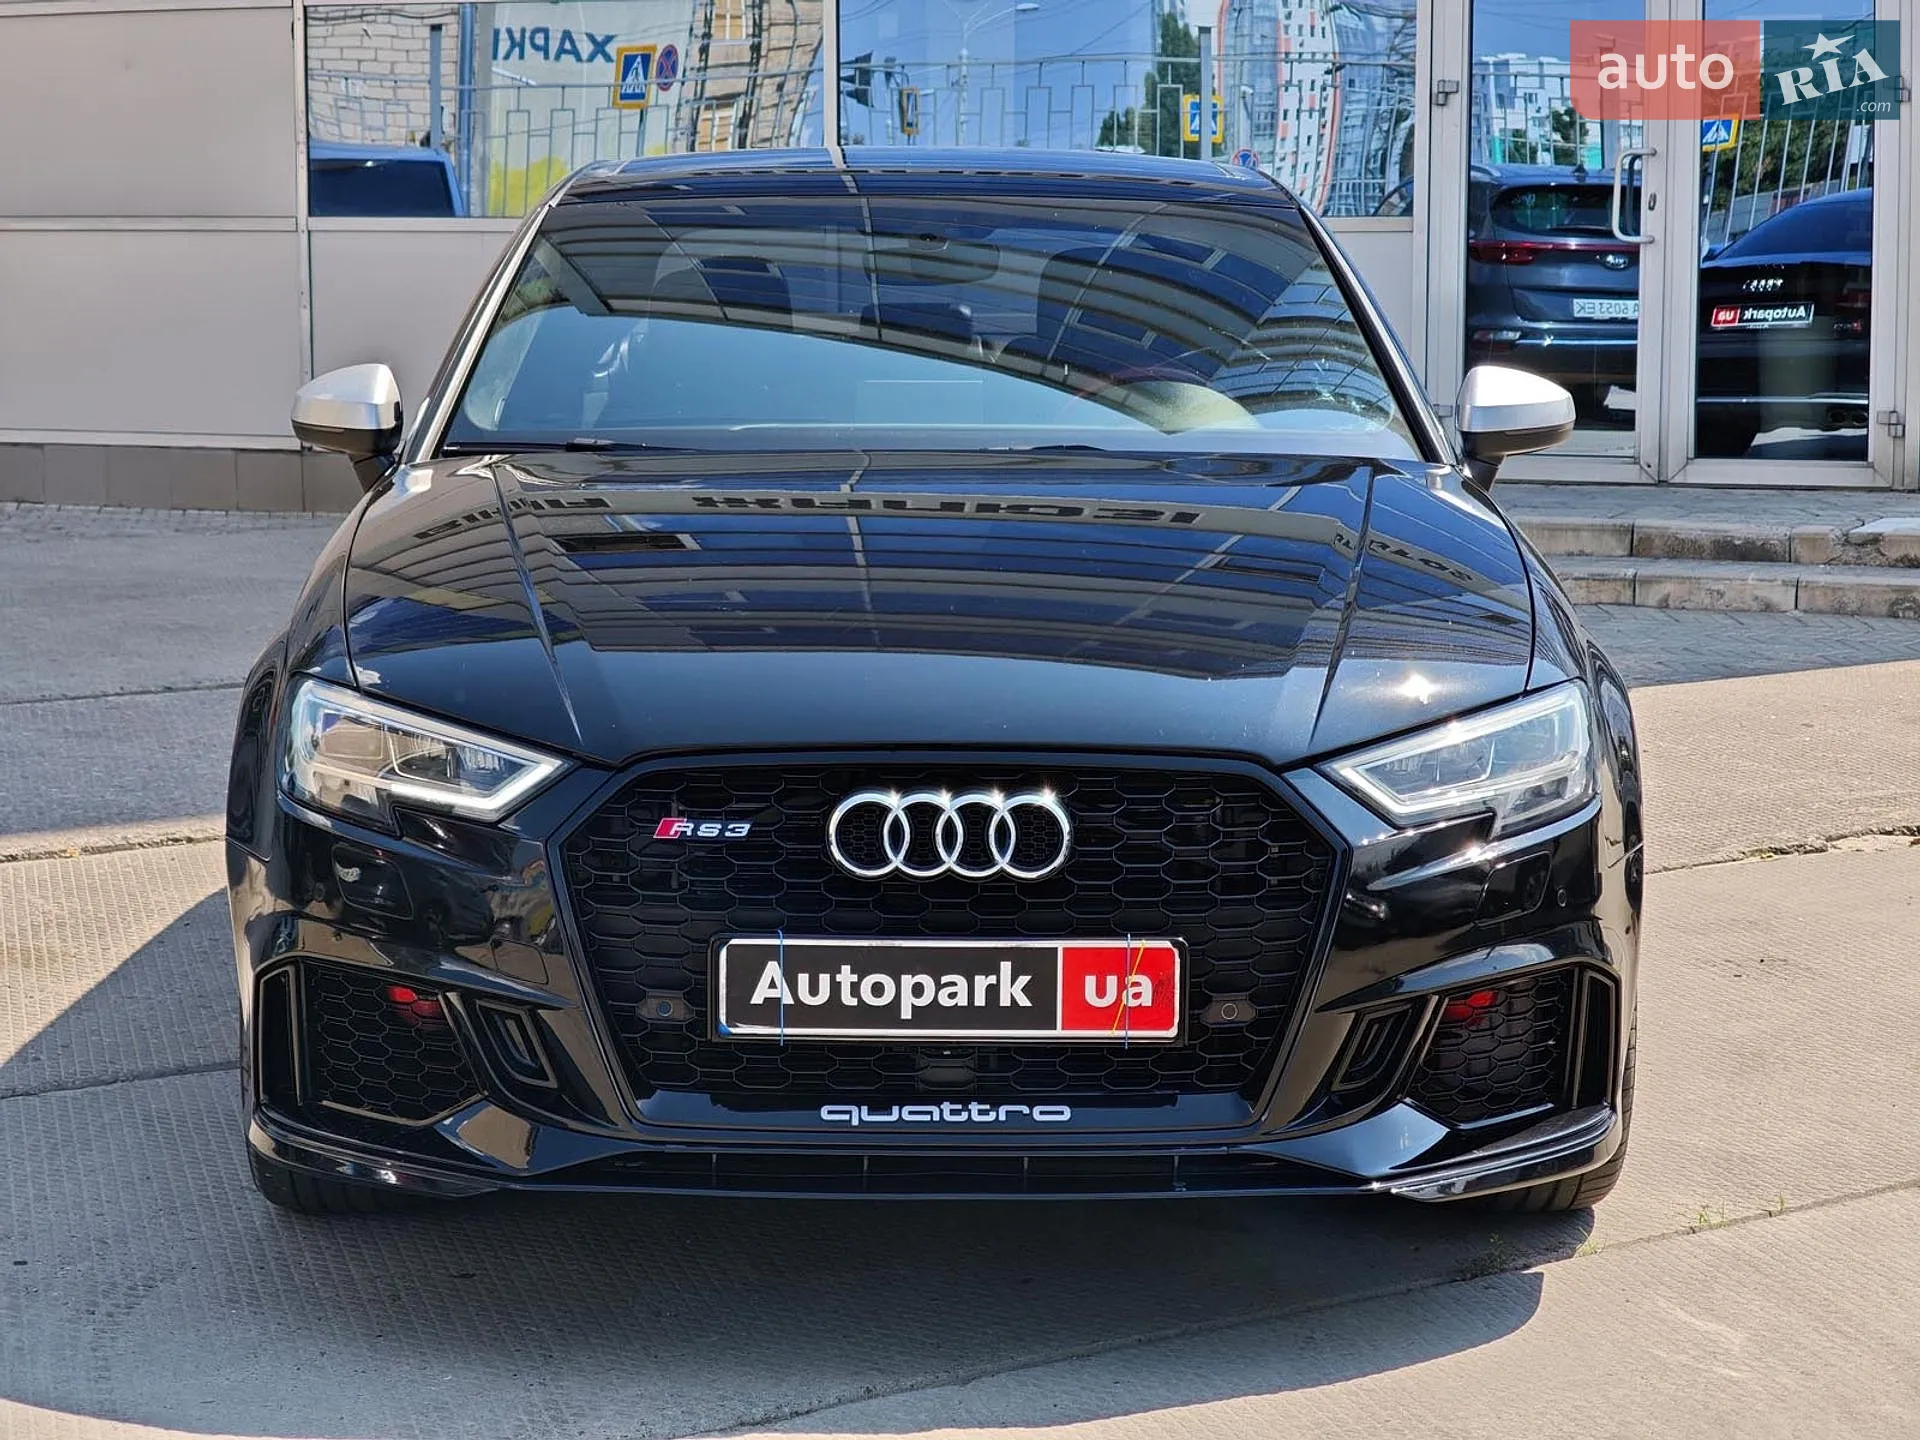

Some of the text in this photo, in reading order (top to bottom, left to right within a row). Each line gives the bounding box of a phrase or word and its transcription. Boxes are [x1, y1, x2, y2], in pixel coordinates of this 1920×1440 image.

[669, 822, 751, 837] RS3
[750, 961, 1153, 1019] Autopark ua
[820, 1101, 1071, 1125] quattro
